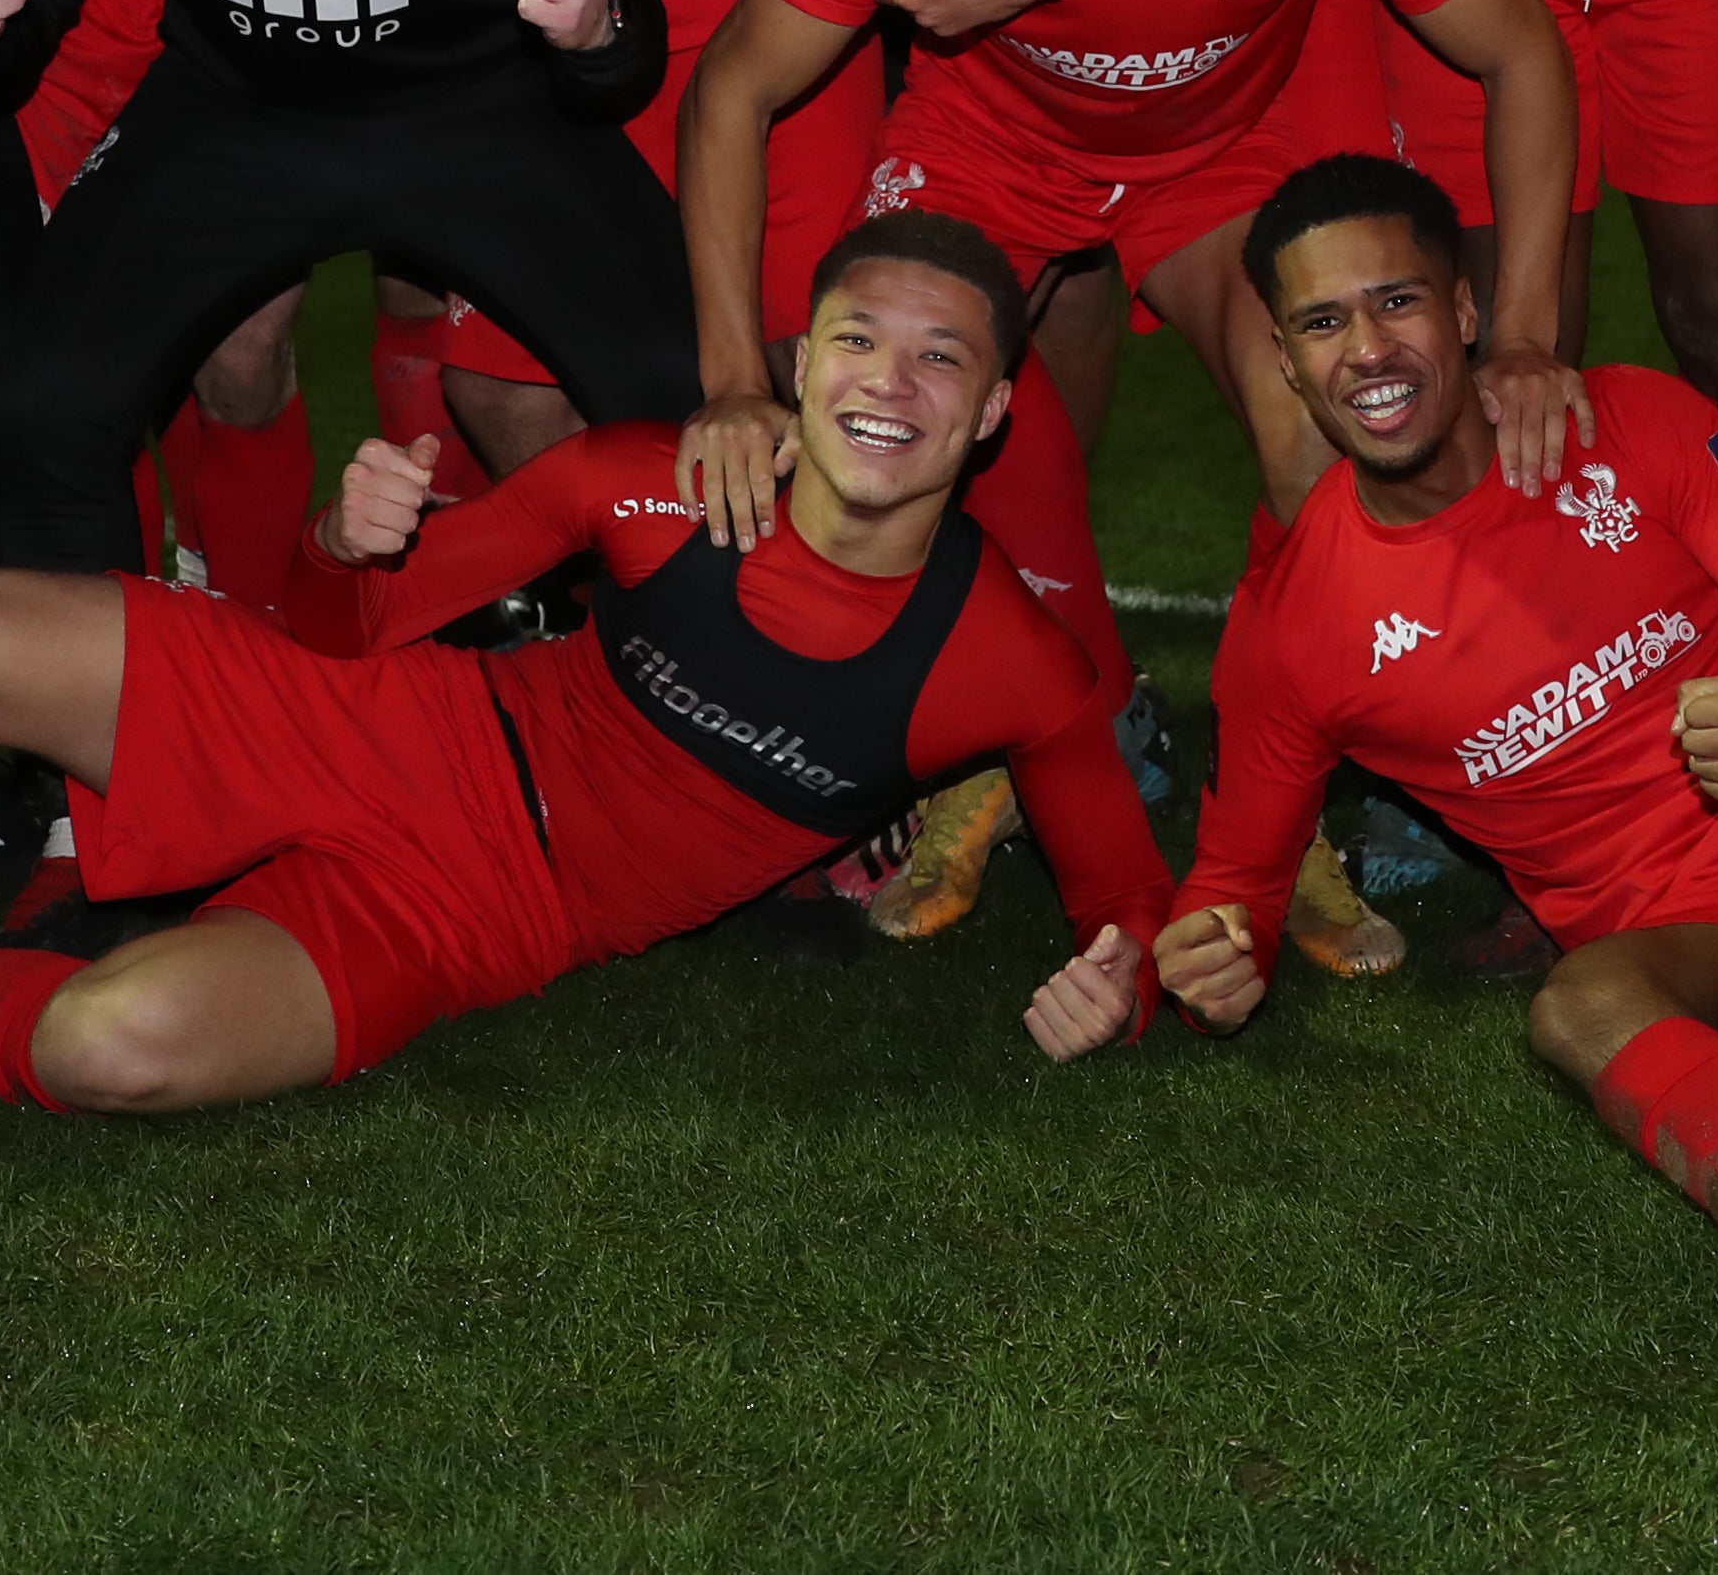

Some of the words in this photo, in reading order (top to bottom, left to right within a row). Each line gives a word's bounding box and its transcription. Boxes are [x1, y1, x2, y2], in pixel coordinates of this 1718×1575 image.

[229, 10, 400, 48] group
[1048, 47, 1195, 69] ADAM
[1461, 656, 1638, 785] HEWITT
[1506, 630, 1637, 738] ADAM
